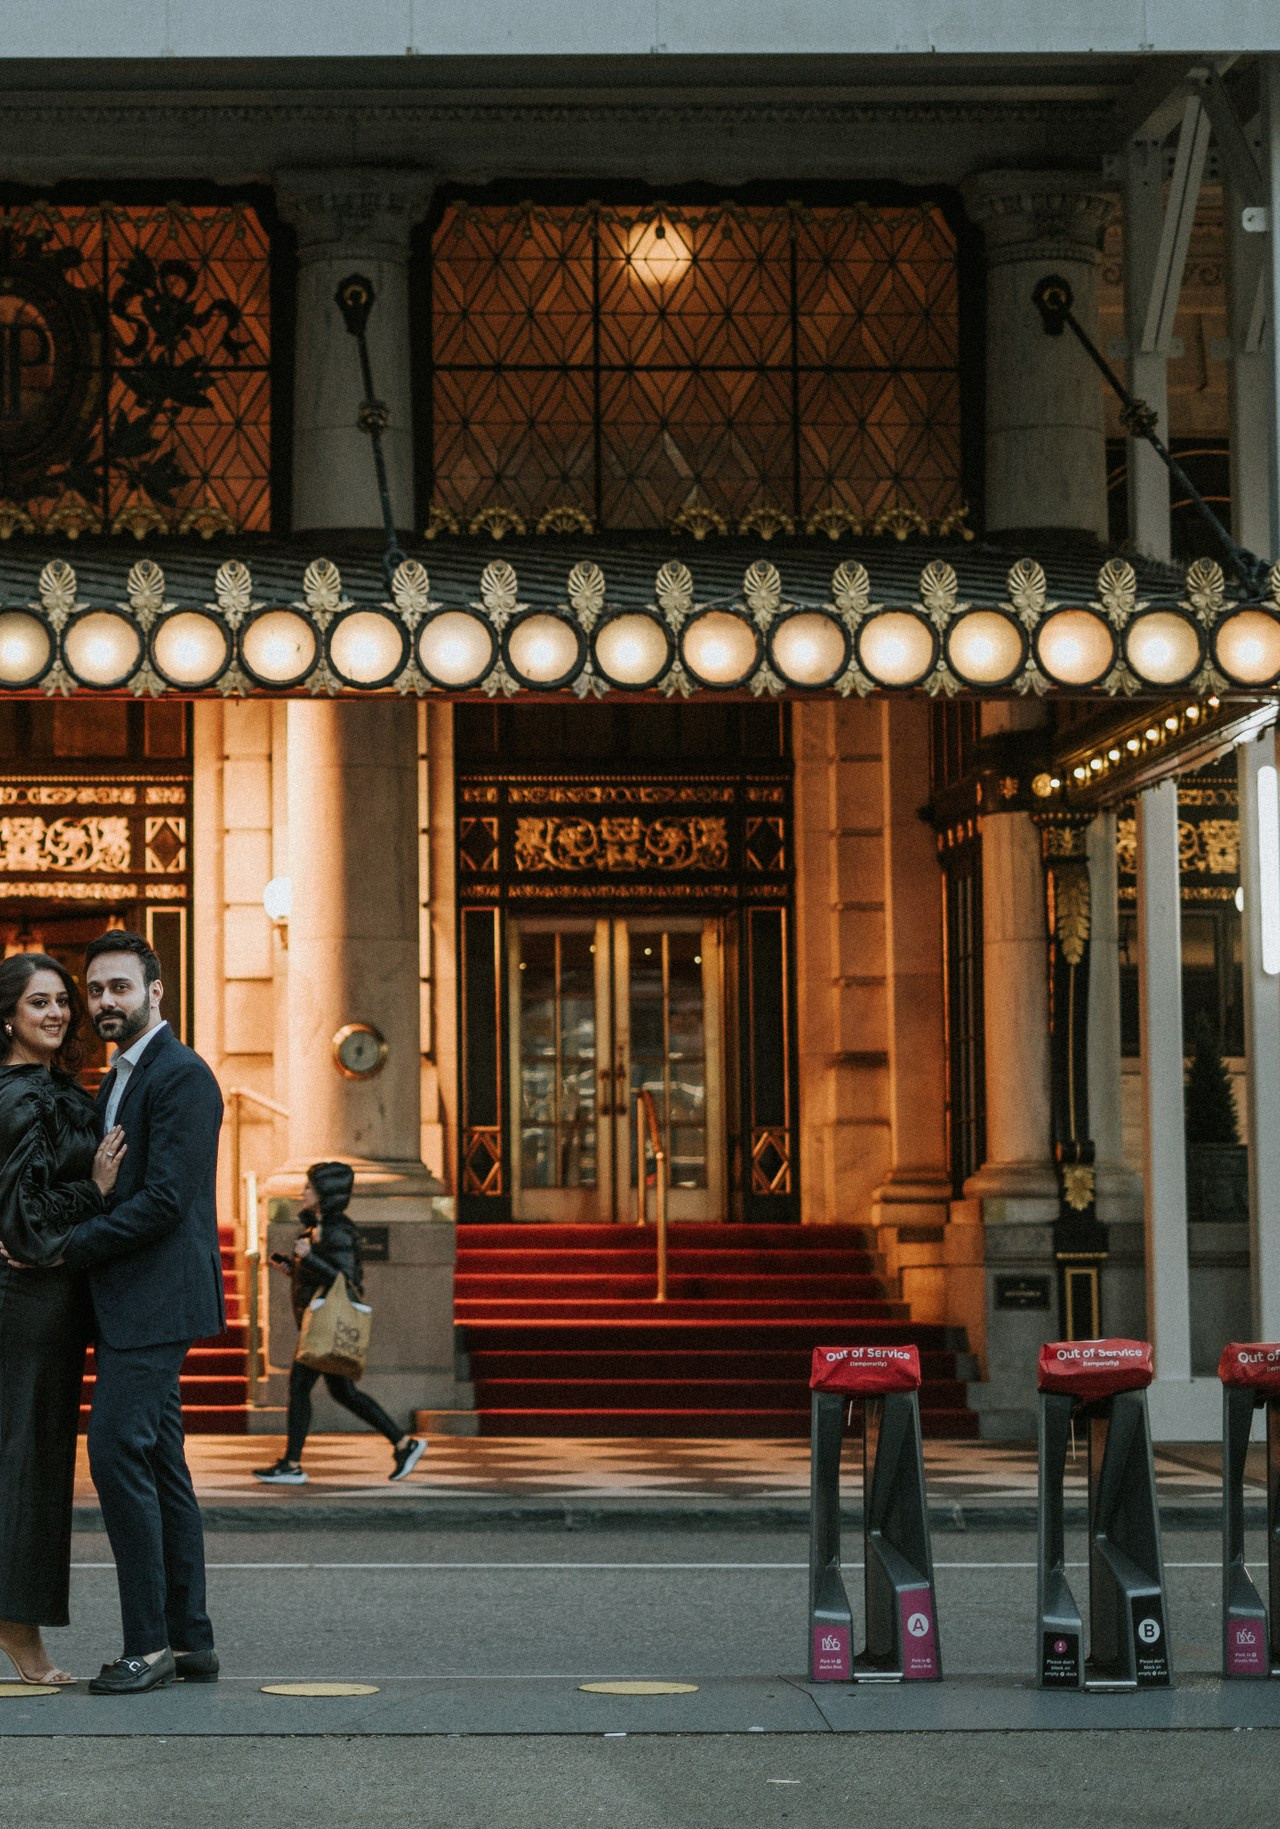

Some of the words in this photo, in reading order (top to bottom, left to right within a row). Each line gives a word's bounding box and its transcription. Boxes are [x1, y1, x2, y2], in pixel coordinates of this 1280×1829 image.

[826, 1350, 848, 1362] Out
[851, 1348, 864, 1358] of
[867, 1348, 911, 1360] Service
[1056, 1349, 1080, 1361] Out
[1083, 1348, 1095, 1358] of
[1098, 1348, 1143, 1357] Service
[1238, 1352, 1264, 1363] Out
[1267, 1349, 1280, 1361] of
[912, 1618, 924, 1632] A
[1144, 1624, 1155, 1638] B
